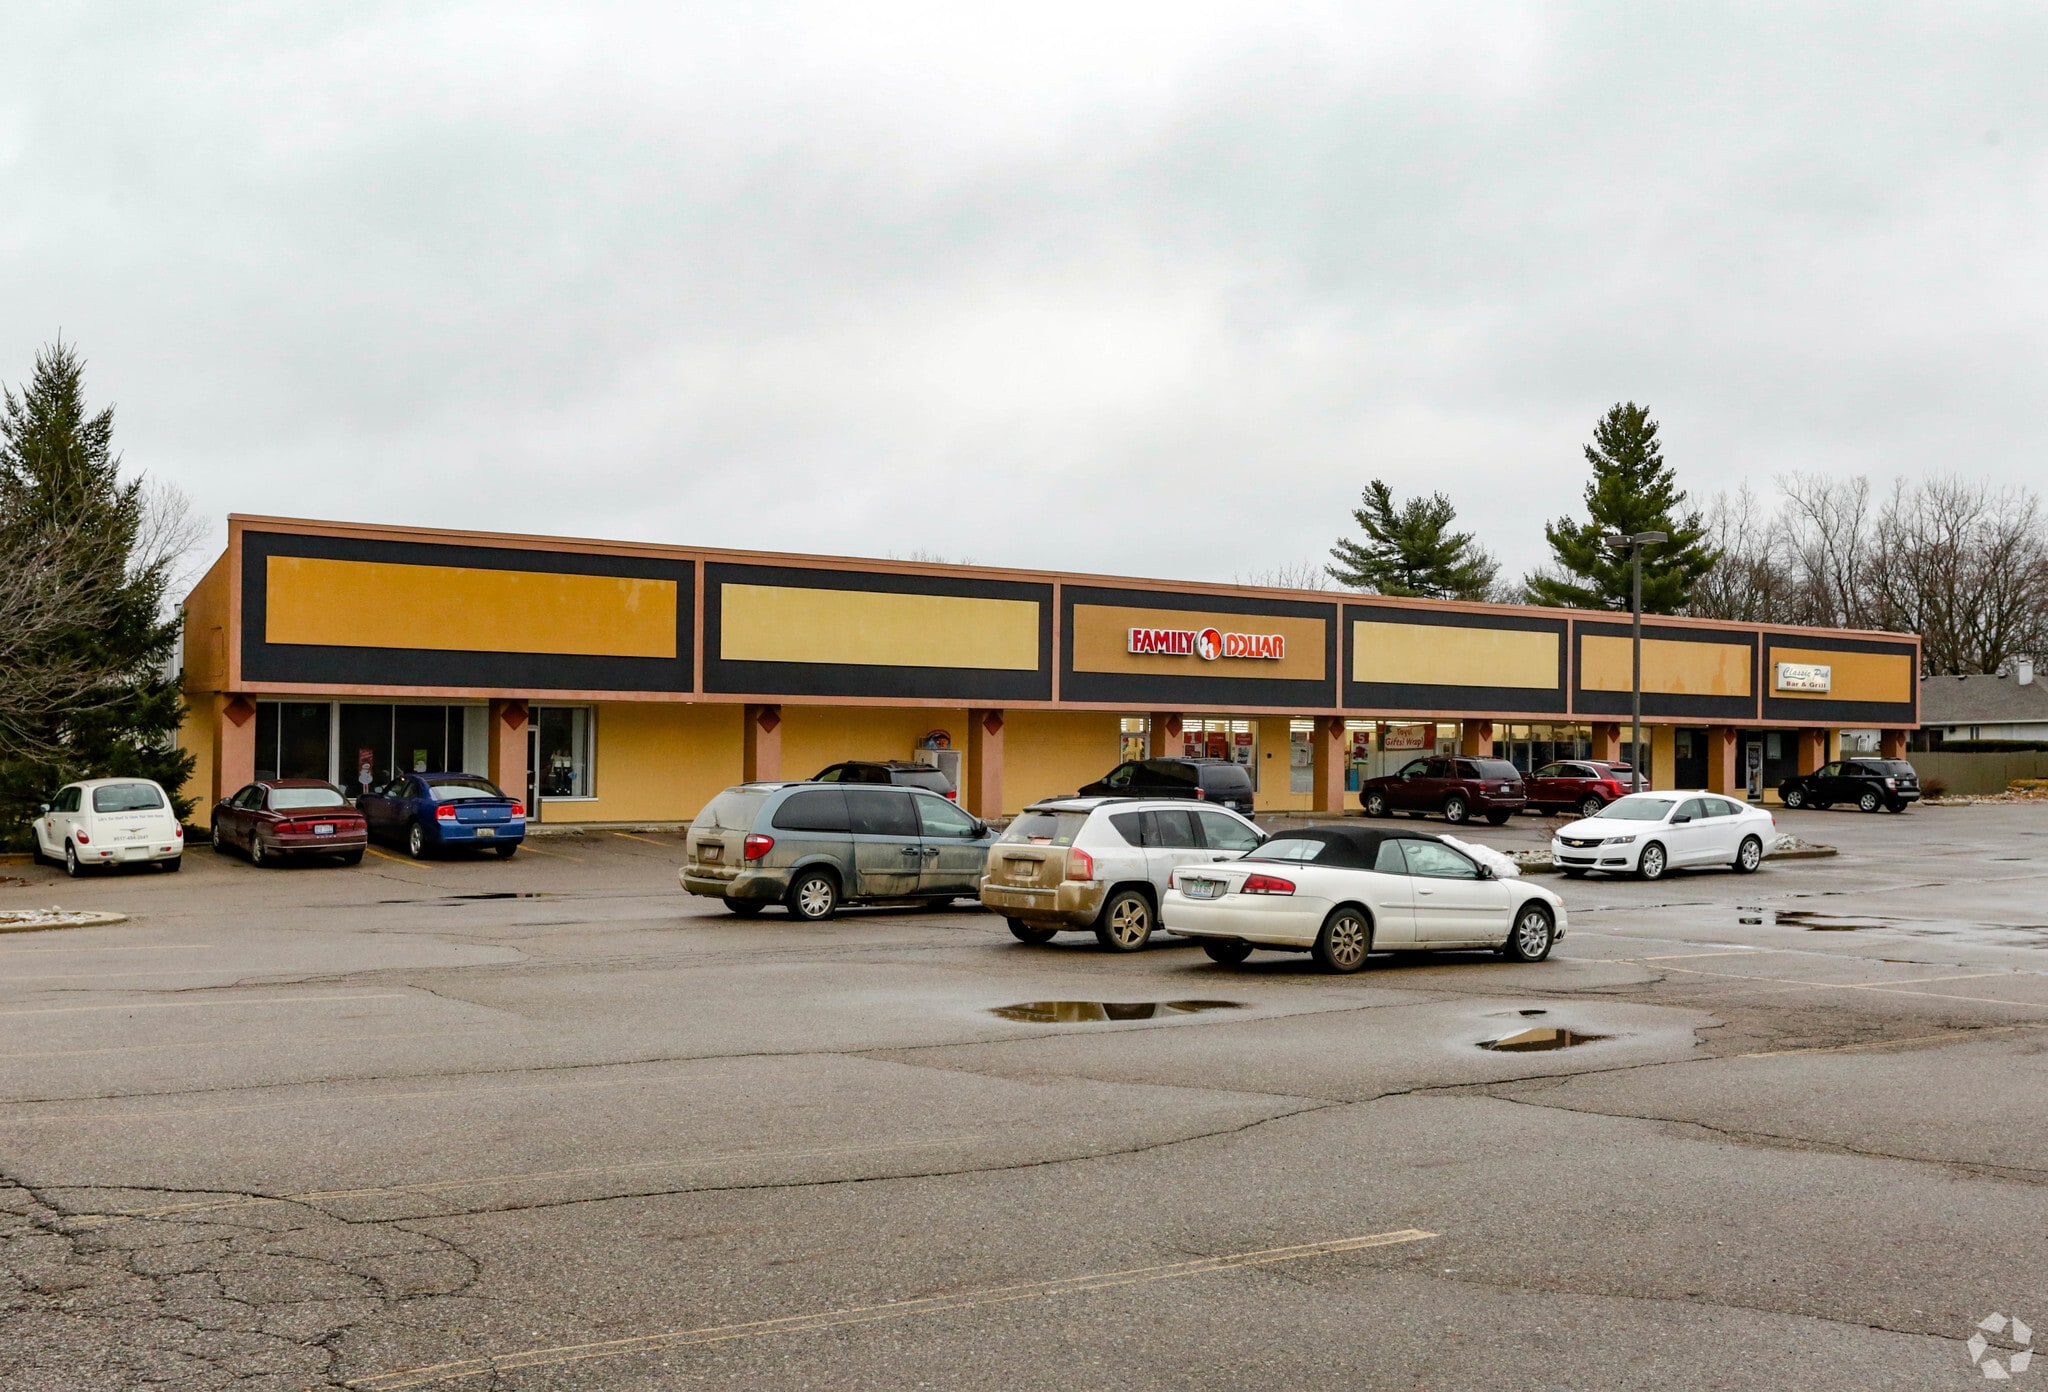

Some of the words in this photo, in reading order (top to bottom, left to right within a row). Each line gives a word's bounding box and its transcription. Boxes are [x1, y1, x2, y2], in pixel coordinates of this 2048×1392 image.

[1131, 629, 1197, 654] FAMILY
[1225, 633, 1285, 658] DOLLAR
[1783, 666, 1811, 680] Classic
[1386, 737, 1405, 746] Gifts!
